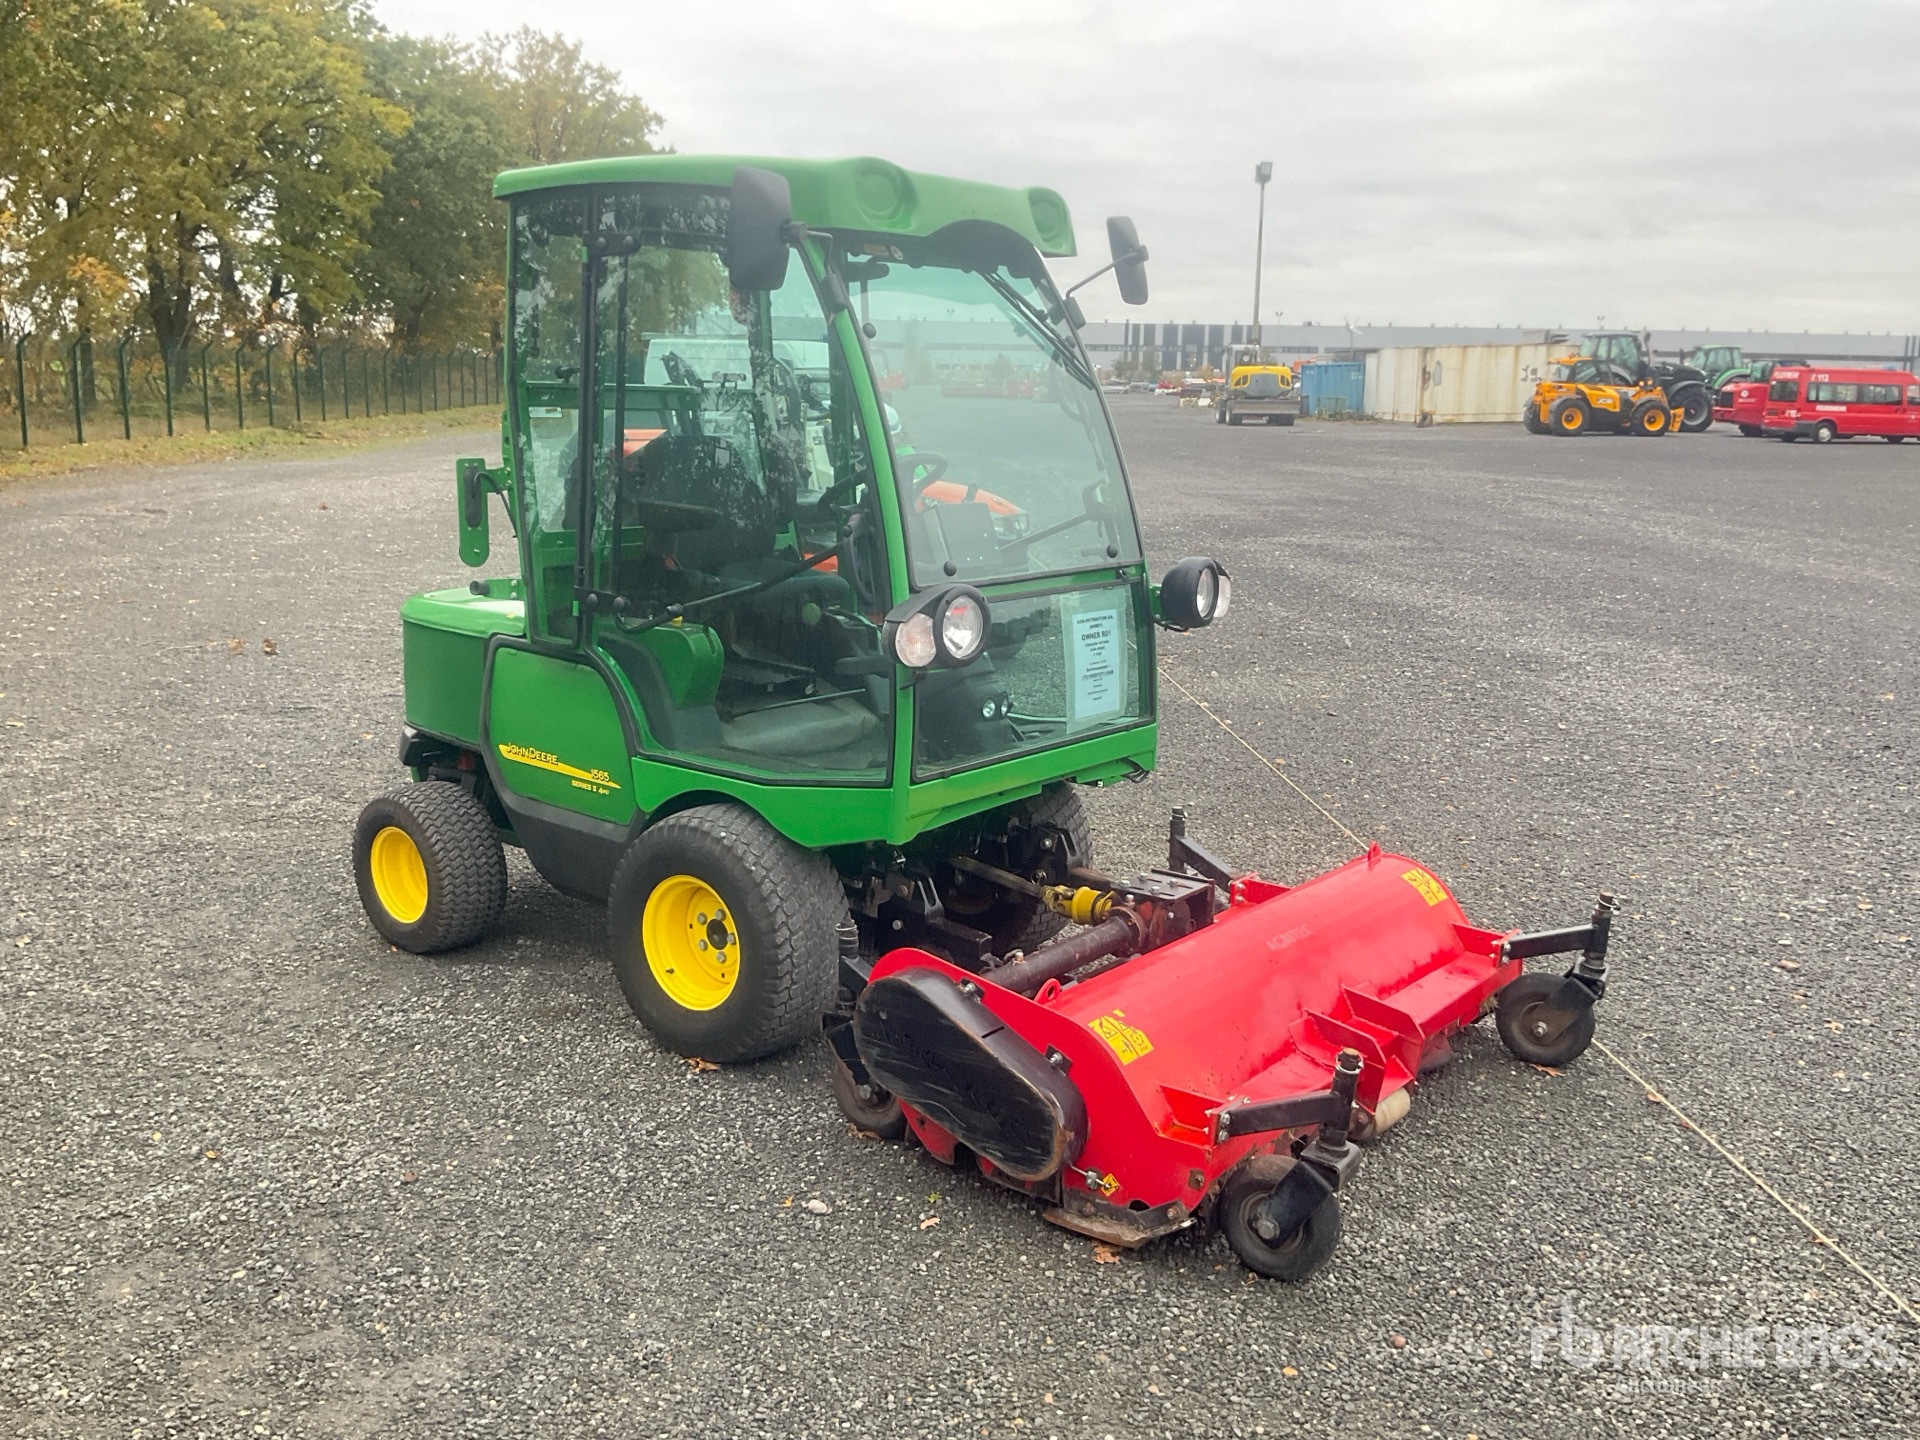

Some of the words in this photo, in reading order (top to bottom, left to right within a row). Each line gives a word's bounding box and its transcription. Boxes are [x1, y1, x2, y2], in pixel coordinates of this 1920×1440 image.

[1817, 373, 1829, 382] 112
[1081, 631, 1101, 641] OWNER
[506, 742, 529, 758] JOHN
[528, 747, 559, 766] DEERE
[590, 769, 610, 782] 1565
[571, 779, 592, 791] SERIES
